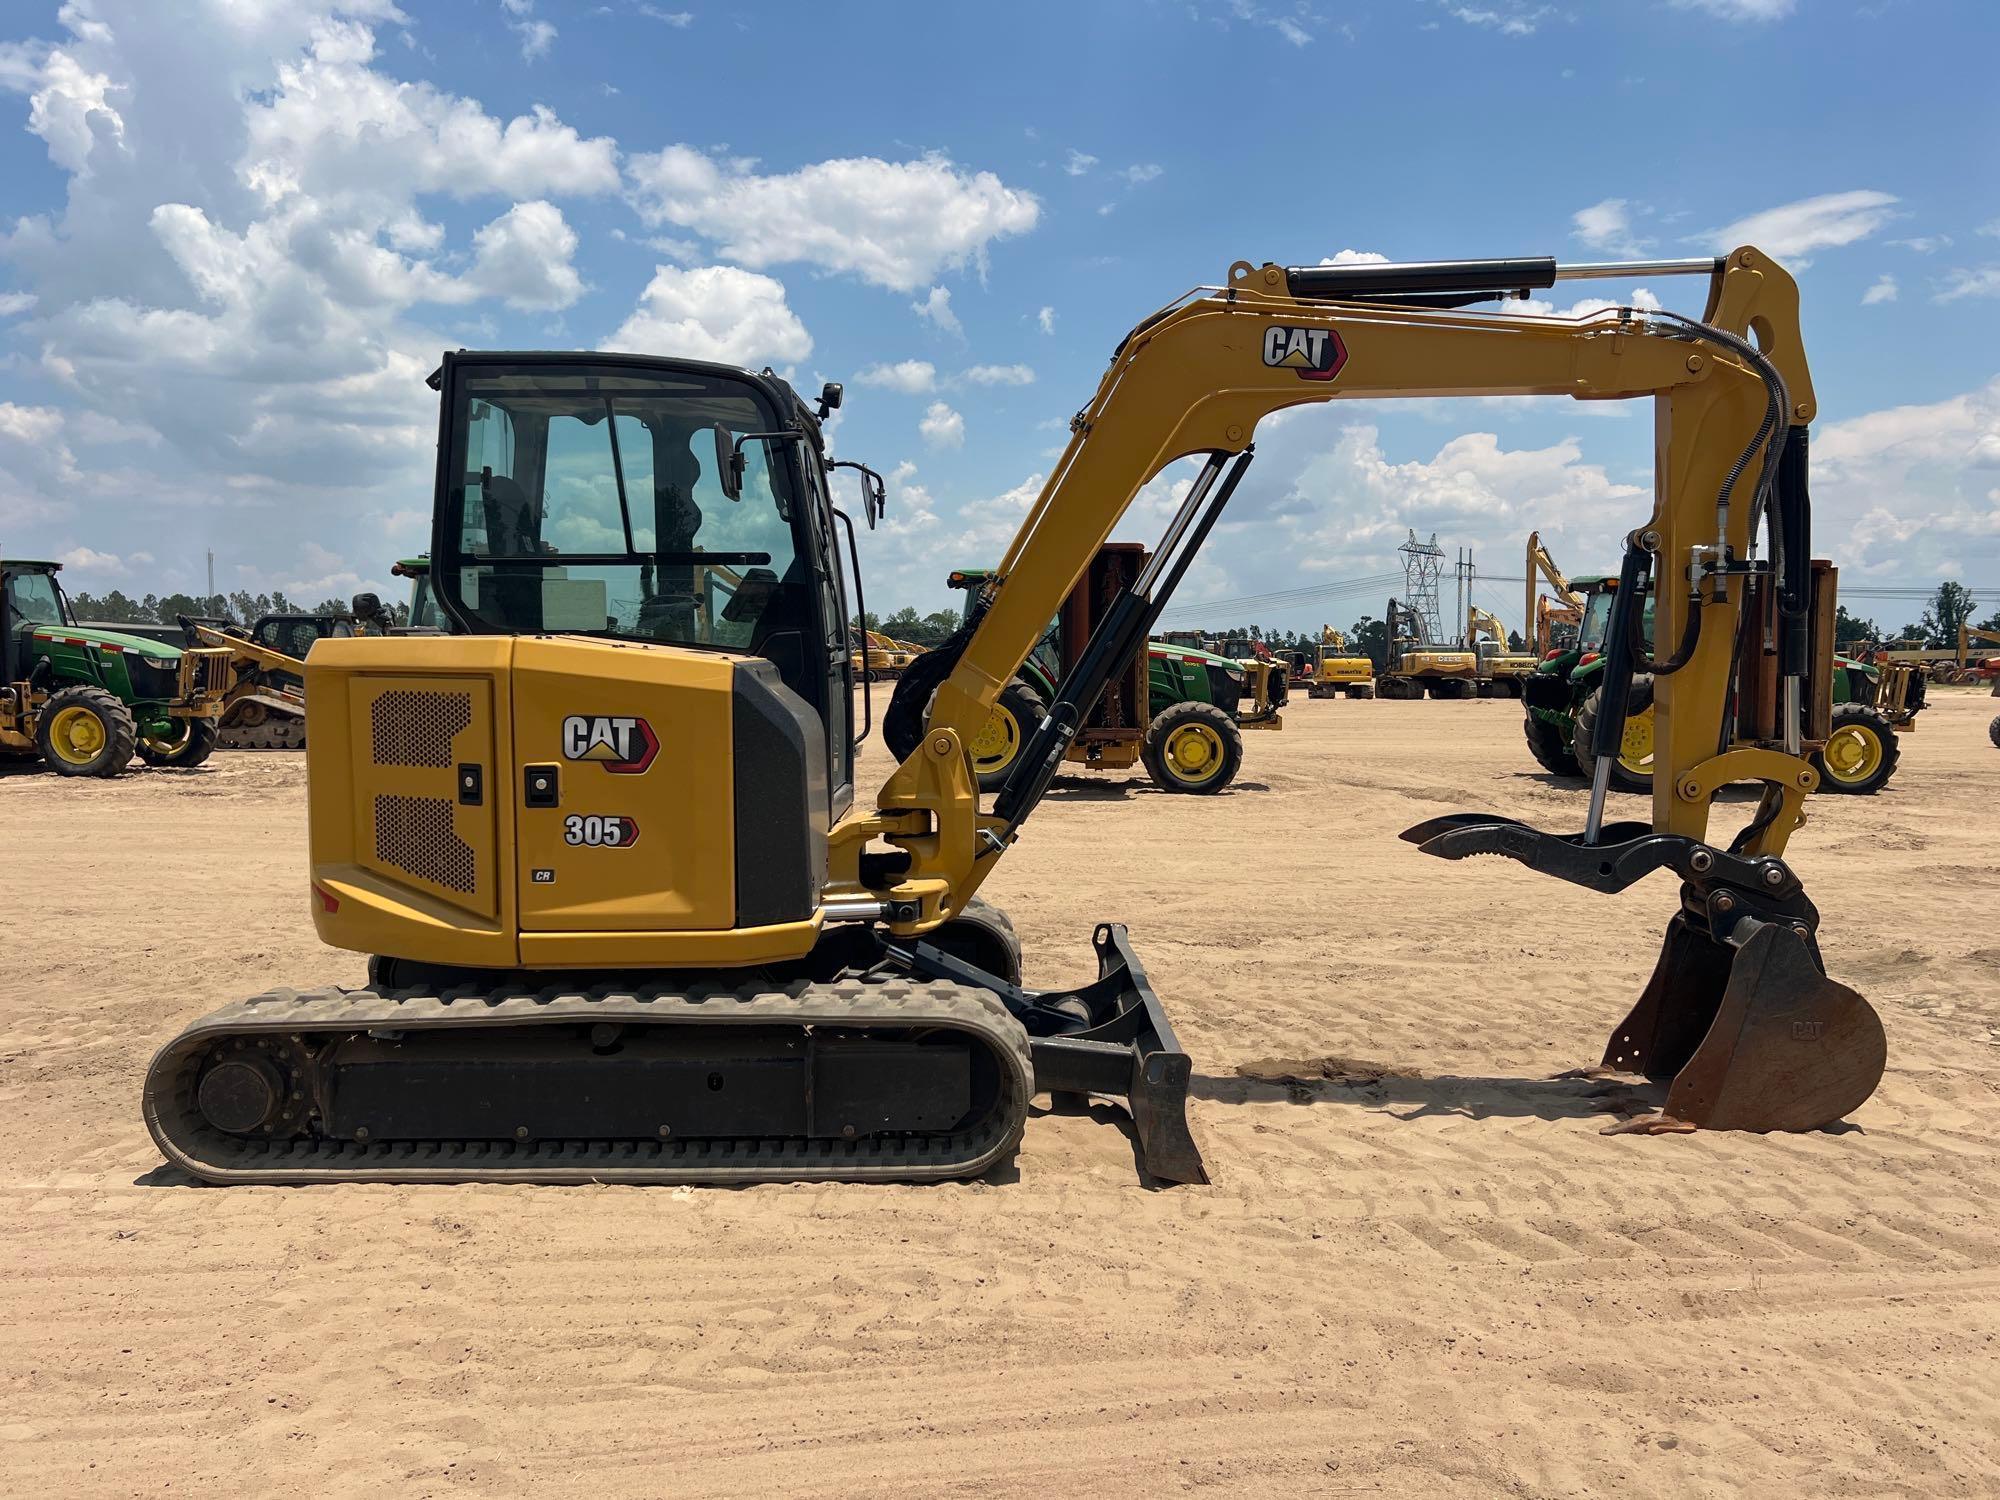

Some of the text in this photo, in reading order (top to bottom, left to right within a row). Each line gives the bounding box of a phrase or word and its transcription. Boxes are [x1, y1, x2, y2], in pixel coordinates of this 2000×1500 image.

[1264, 327, 1329, 369] CAT
[564, 716, 636, 760] CAT
[566, 815, 621, 845] 305
[535, 871, 551, 881] CR
[1792, 1021, 1825, 1041] CAT
